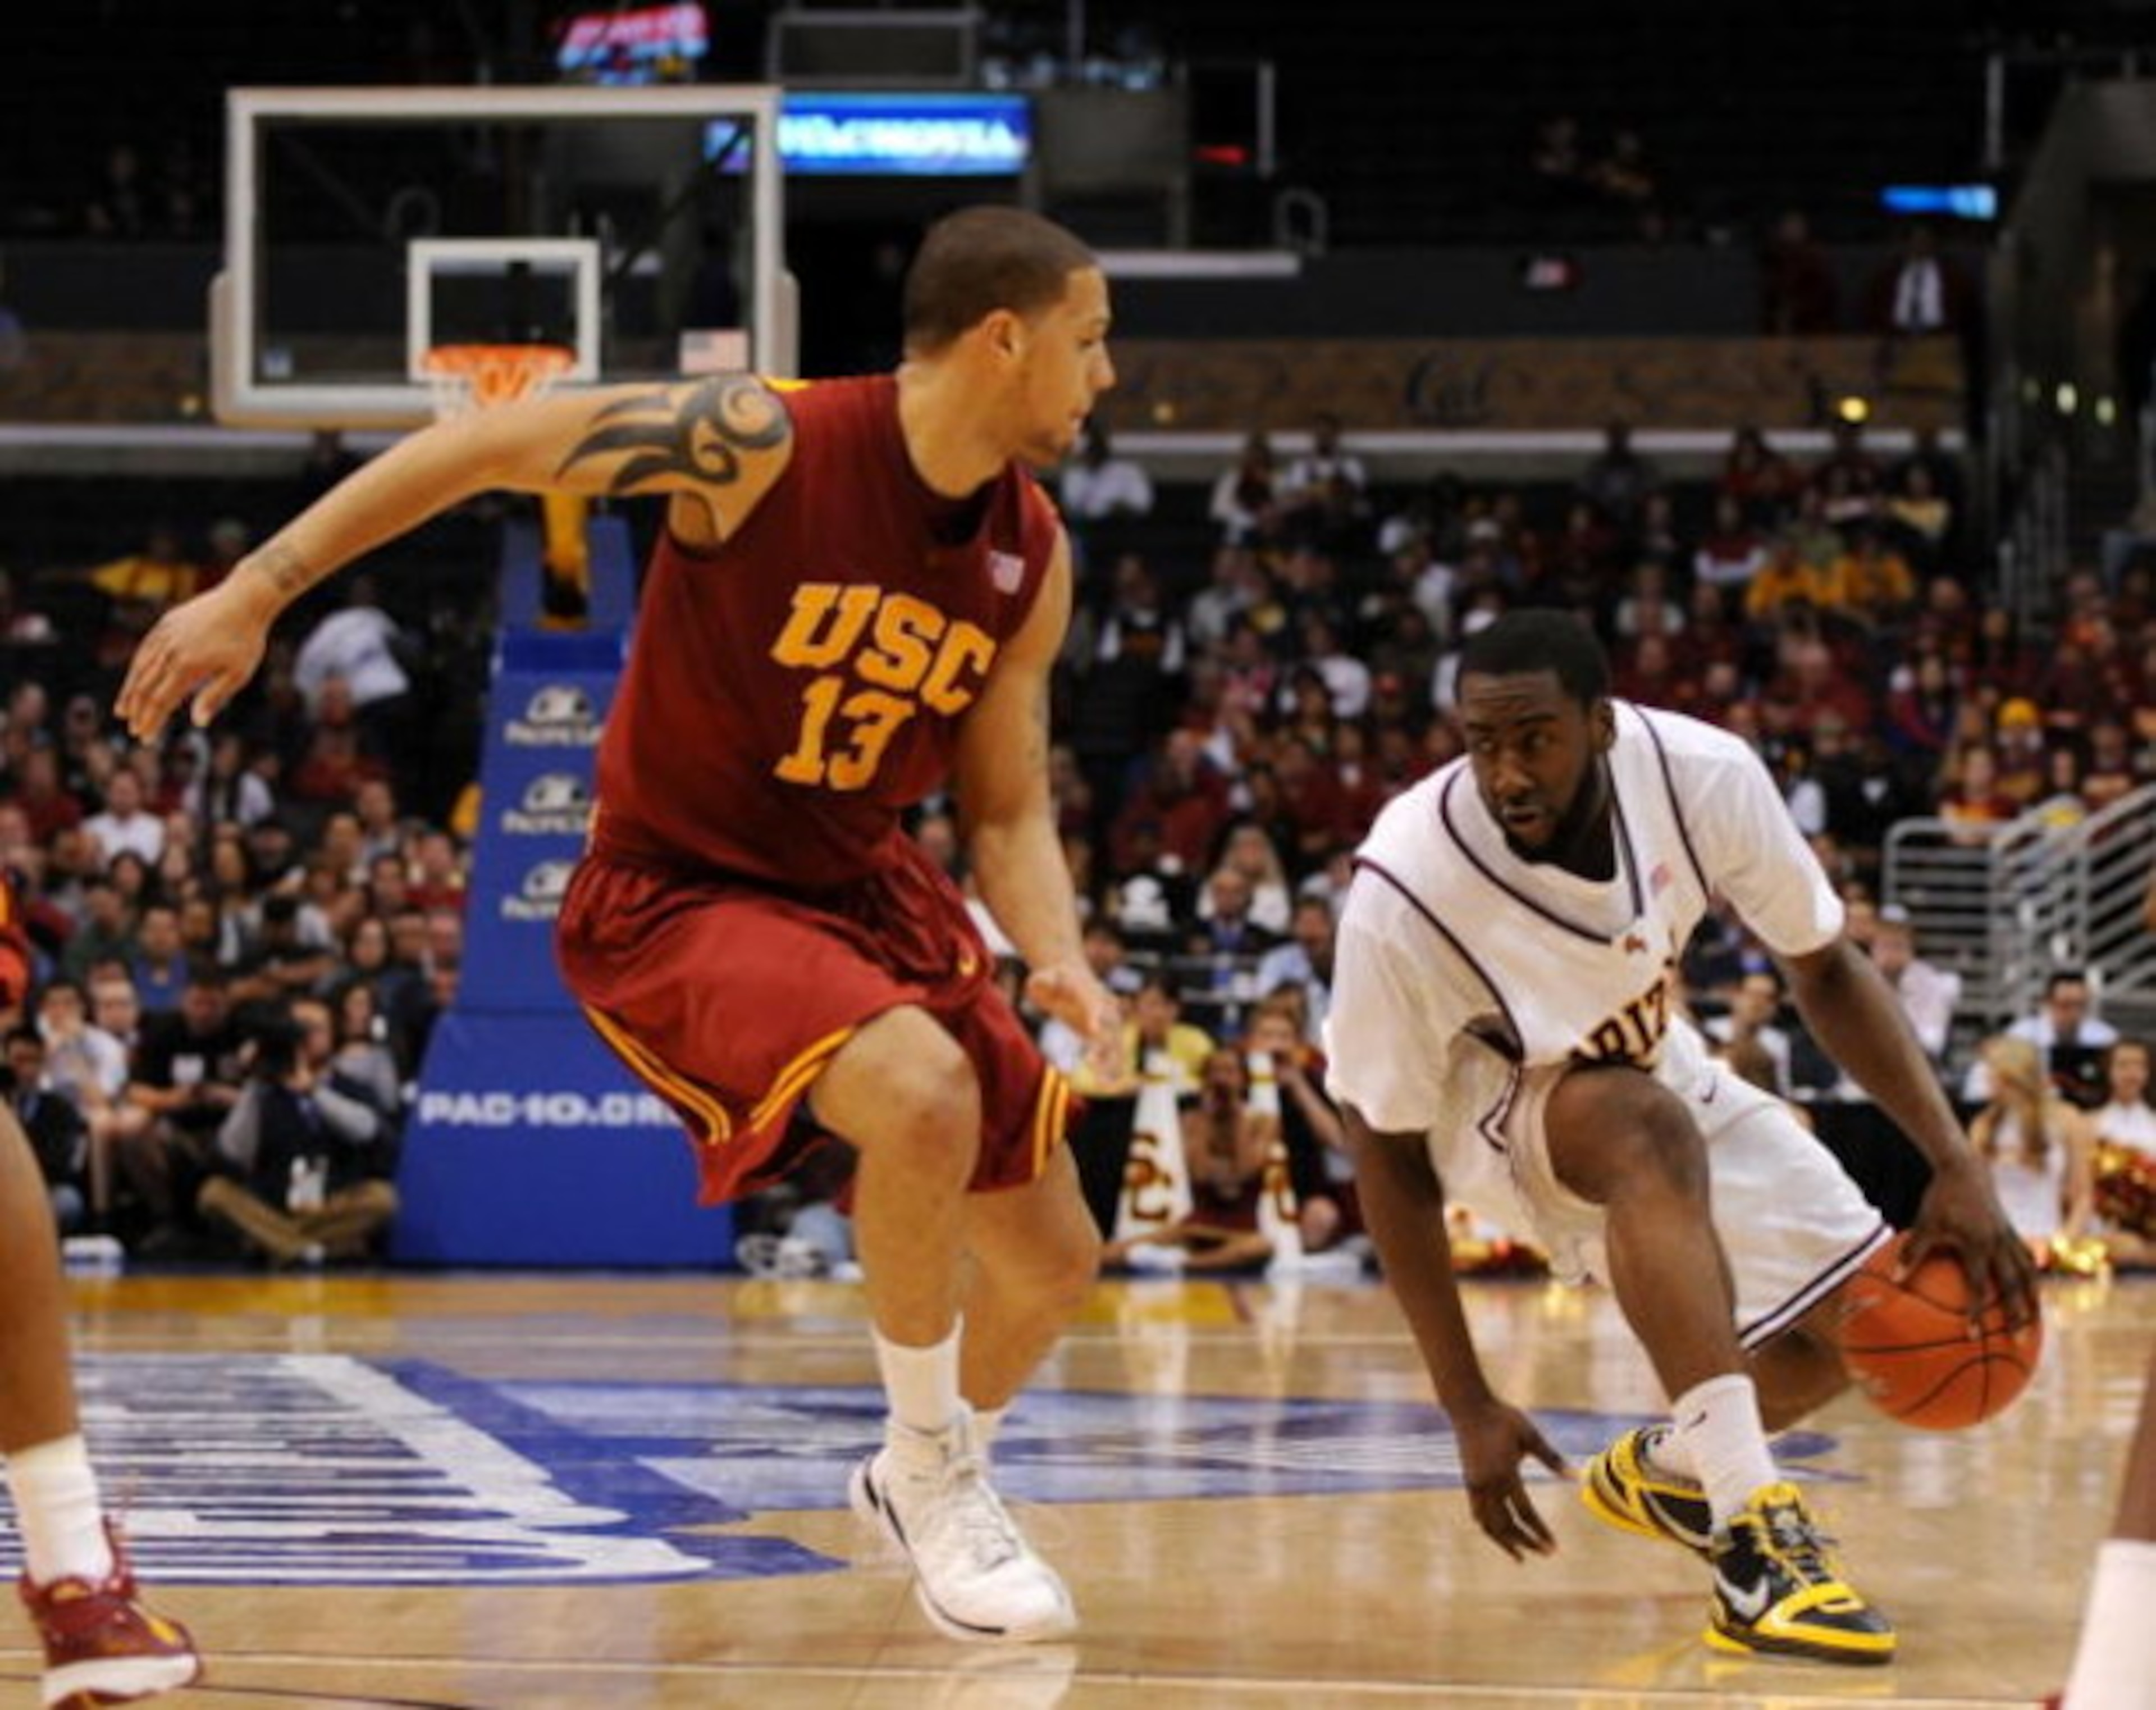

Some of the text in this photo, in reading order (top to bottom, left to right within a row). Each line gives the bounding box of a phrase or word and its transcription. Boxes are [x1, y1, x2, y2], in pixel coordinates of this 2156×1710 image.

[770, 583, 996, 715] USC
[775, 676, 916, 791] 13
[420, 1091, 682, 1127] PAC-10.OR
